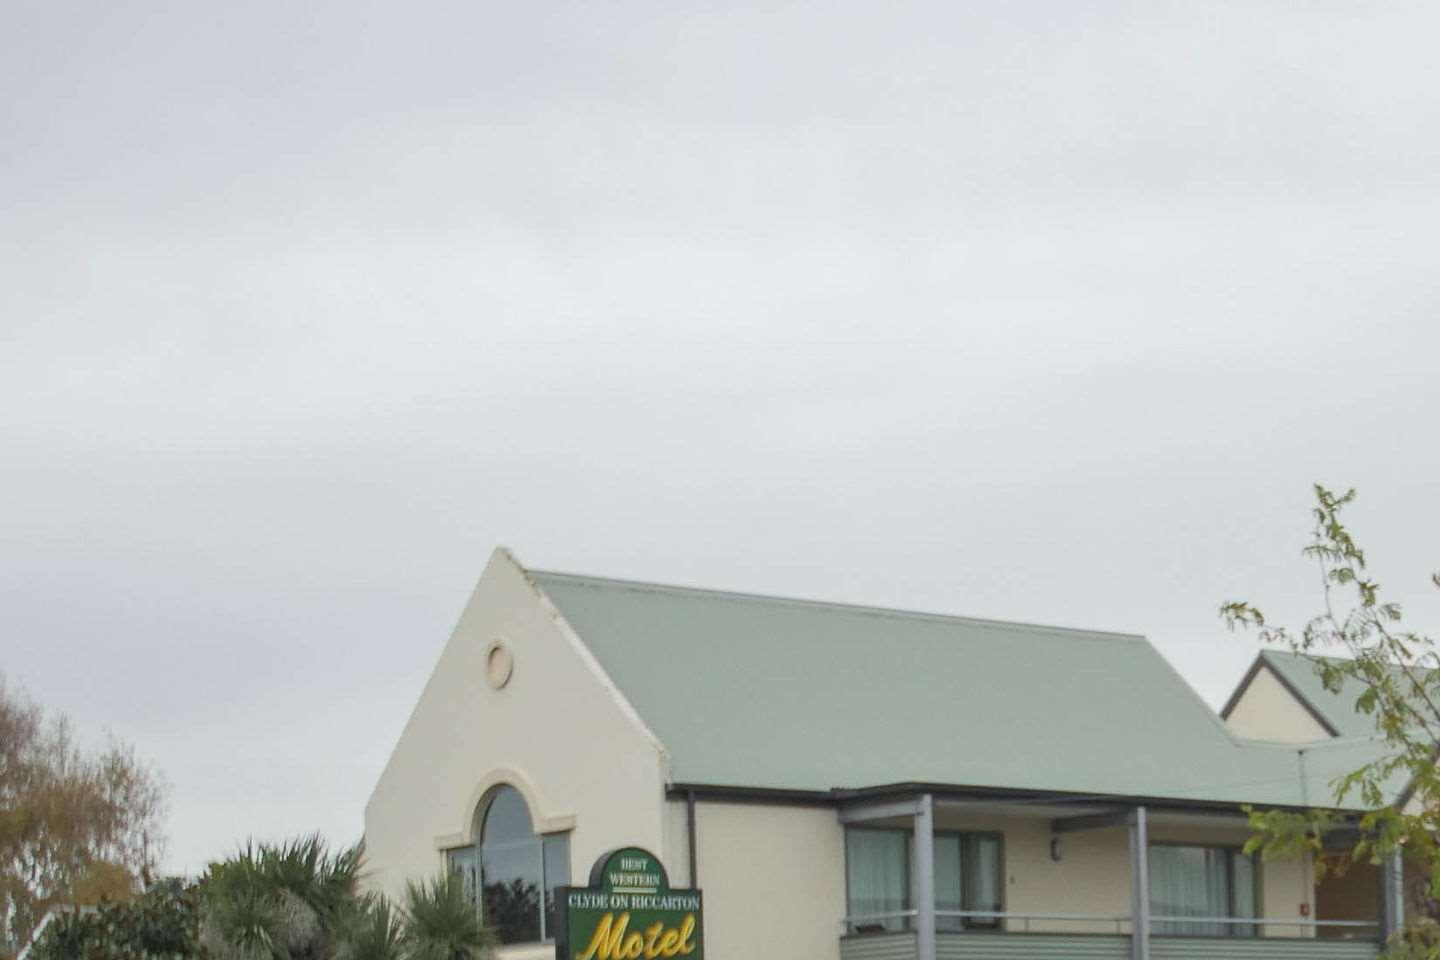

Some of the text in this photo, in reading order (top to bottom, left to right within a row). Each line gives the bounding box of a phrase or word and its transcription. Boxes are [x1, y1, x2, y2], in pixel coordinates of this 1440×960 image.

[622, 858, 648, 870] BEST
[610, 872, 660, 886] WESTERN
[568, 893, 700, 911] CLYDE ON RICCARTON
